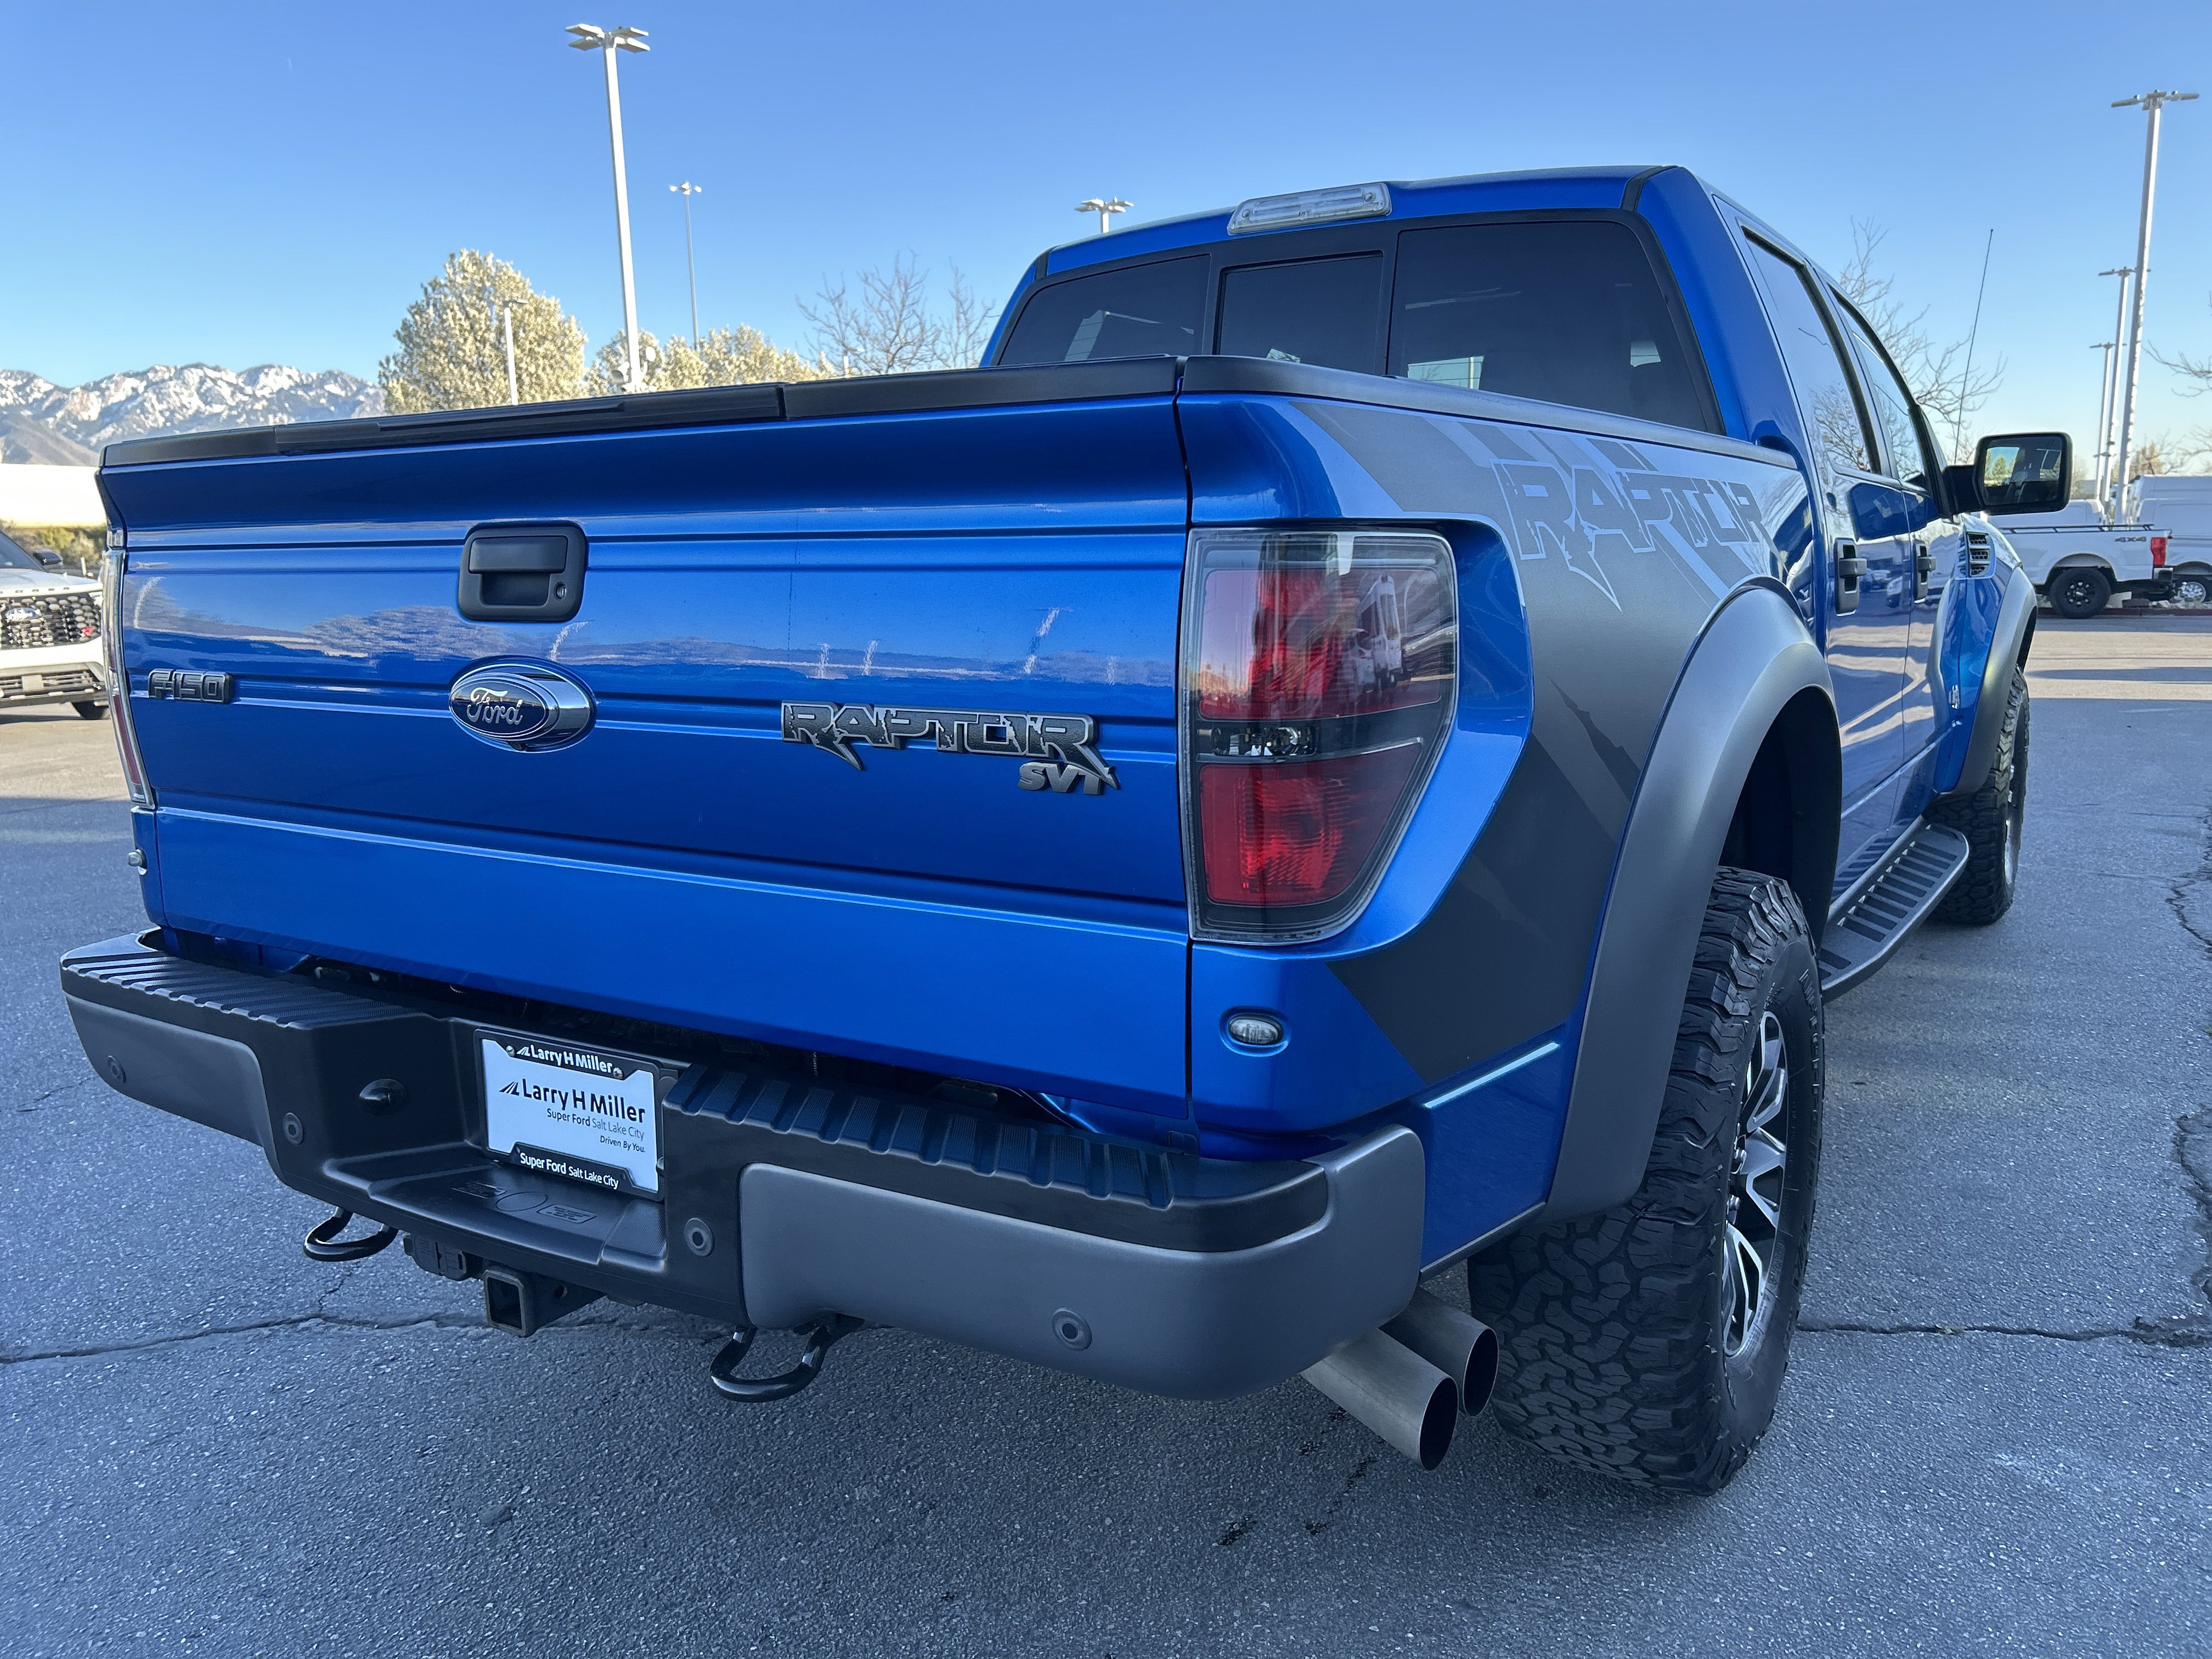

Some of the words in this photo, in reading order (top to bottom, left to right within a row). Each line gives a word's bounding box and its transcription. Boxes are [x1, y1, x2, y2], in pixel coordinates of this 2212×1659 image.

[1490, 458, 1788, 612] RAPTOR
[466, 686, 523, 725] Ford
[781, 699, 1120, 791] RAPTOR
[1017, 761, 1106, 795] SVT
[531, 1044, 562, 1066] Larry
[563, 1051, 574, 1065] H
[575, 1053, 613, 1073] Miller
[522, 1078, 568, 1110] Larry
[572, 1089, 586, 1110] H
[590, 1093, 645, 1123] Miller
[547, 1108, 570, 1122] Super
[572, 1113, 590, 1126] Ford
[592, 1118, 607, 1131] Salt
[608, 1121, 627, 1135] Lake
[628, 1126, 645, 1141] City
[600, 1135, 621, 1147] Driven
[623, 1141, 631, 1151] By
[520, 1152, 545, 1169] Super
[546, 1159, 566, 1175] Ford
[568, 1166, 584, 1179] Salt
[584, 1170, 602, 1183] Lake
[603, 1175, 619, 1190] City
